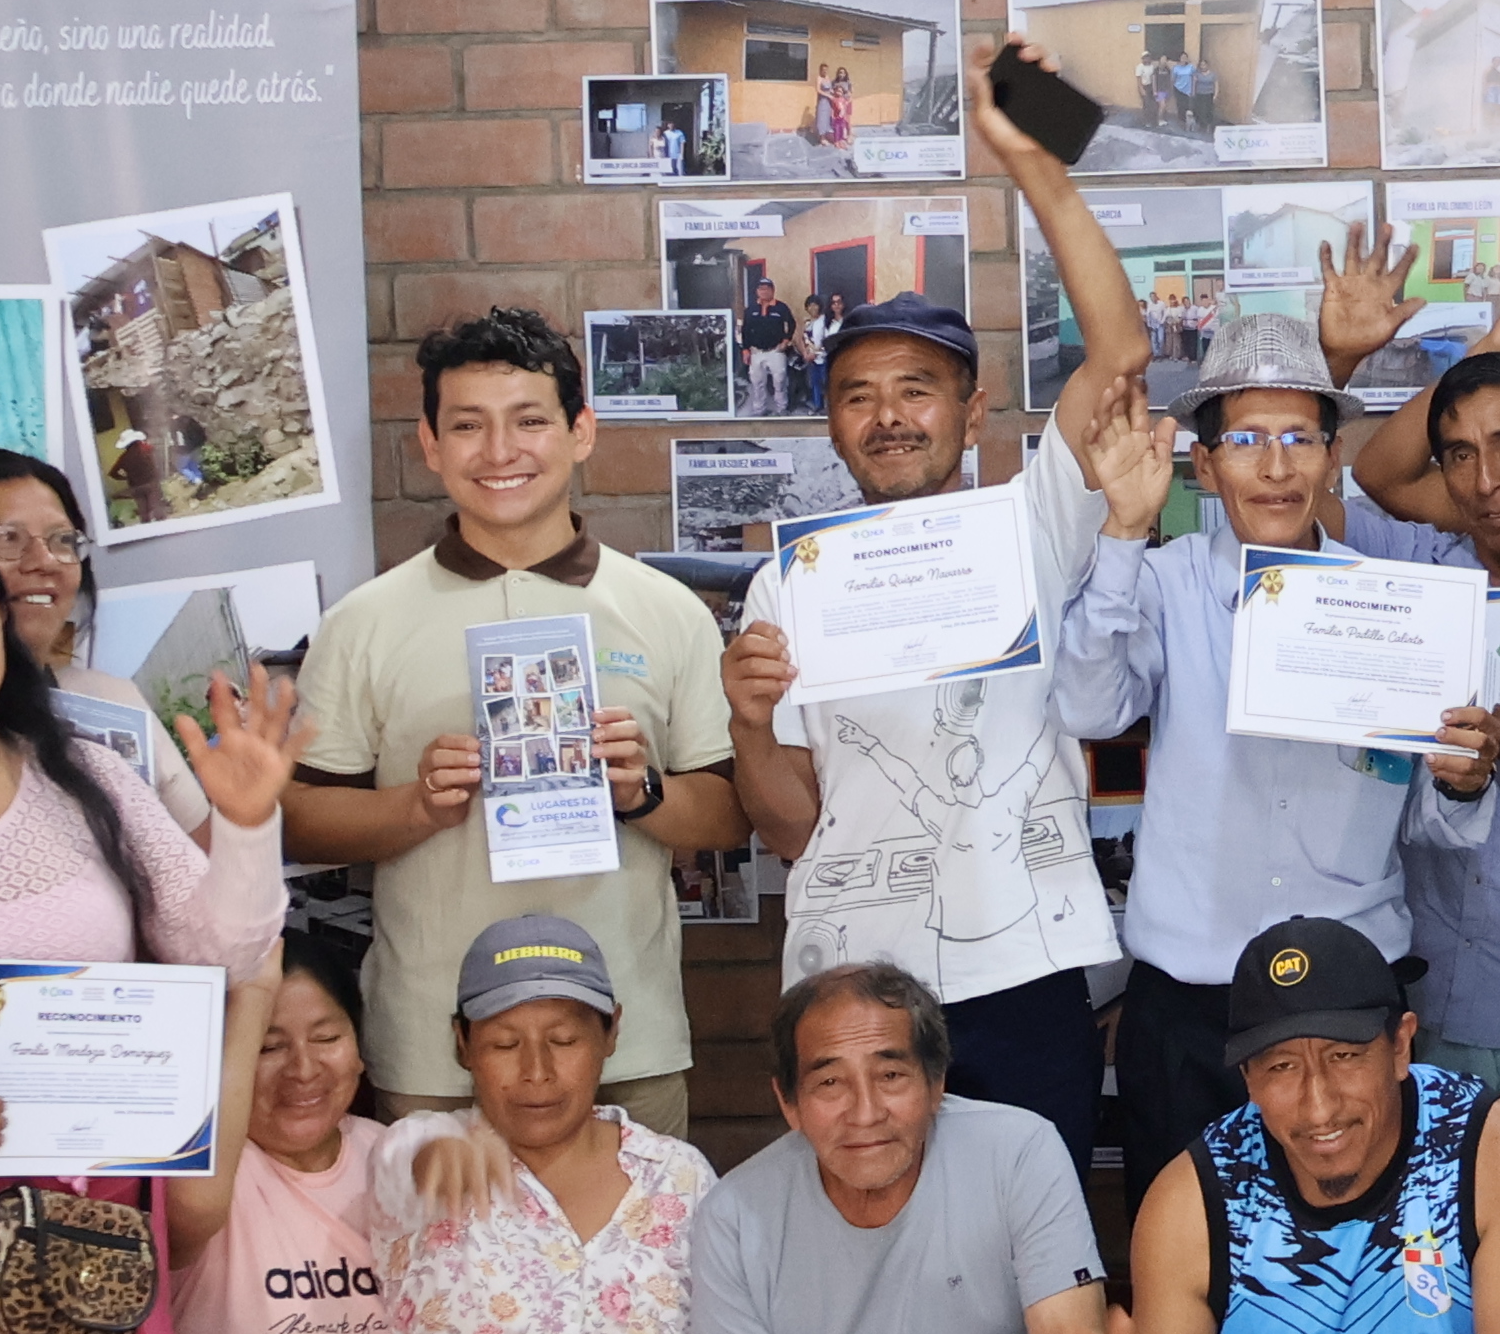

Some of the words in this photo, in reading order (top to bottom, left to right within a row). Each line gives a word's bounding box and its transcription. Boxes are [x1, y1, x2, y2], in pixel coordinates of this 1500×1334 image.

[59, 17, 109, 52] sino
[118, 22, 164, 50] una
[170, 10, 275, 50] realidad.
[24, 71, 101, 106] donde
[106, 70, 175, 106] nadie
[181, 68, 252, 120] quede
[1407, 202, 1435, 211] FAMILIA
[685, 221, 712, 231] FAMILIA
[688, 458, 715, 468] FAMILIA
[853, 538, 953, 561] RECONOCIMIENTO
[844, 579, 885, 594] Familia
[888, 573, 924, 589] Quispe
[928, 566, 973, 582] Navarro
[1316, 597, 1412, 614] RECONOCIMIENTO
[1304, 623, 1343, 637] Familia
[1346, 626, 1385, 642] Padilla
[1388, 631, 1425, 646] Calixto
[530, 798, 580, 810] LUGARES
[582, 797, 598, 805] DE
[532, 810, 598, 823] ESPERANZA
[494, 946, 585, 965] LIEBHERR
[1275, 956, 1301, 977] CAT
[37, 1011, 142, 1024] RECONOCIMIENTO
[9, 1041, 50, 1057] Familia
